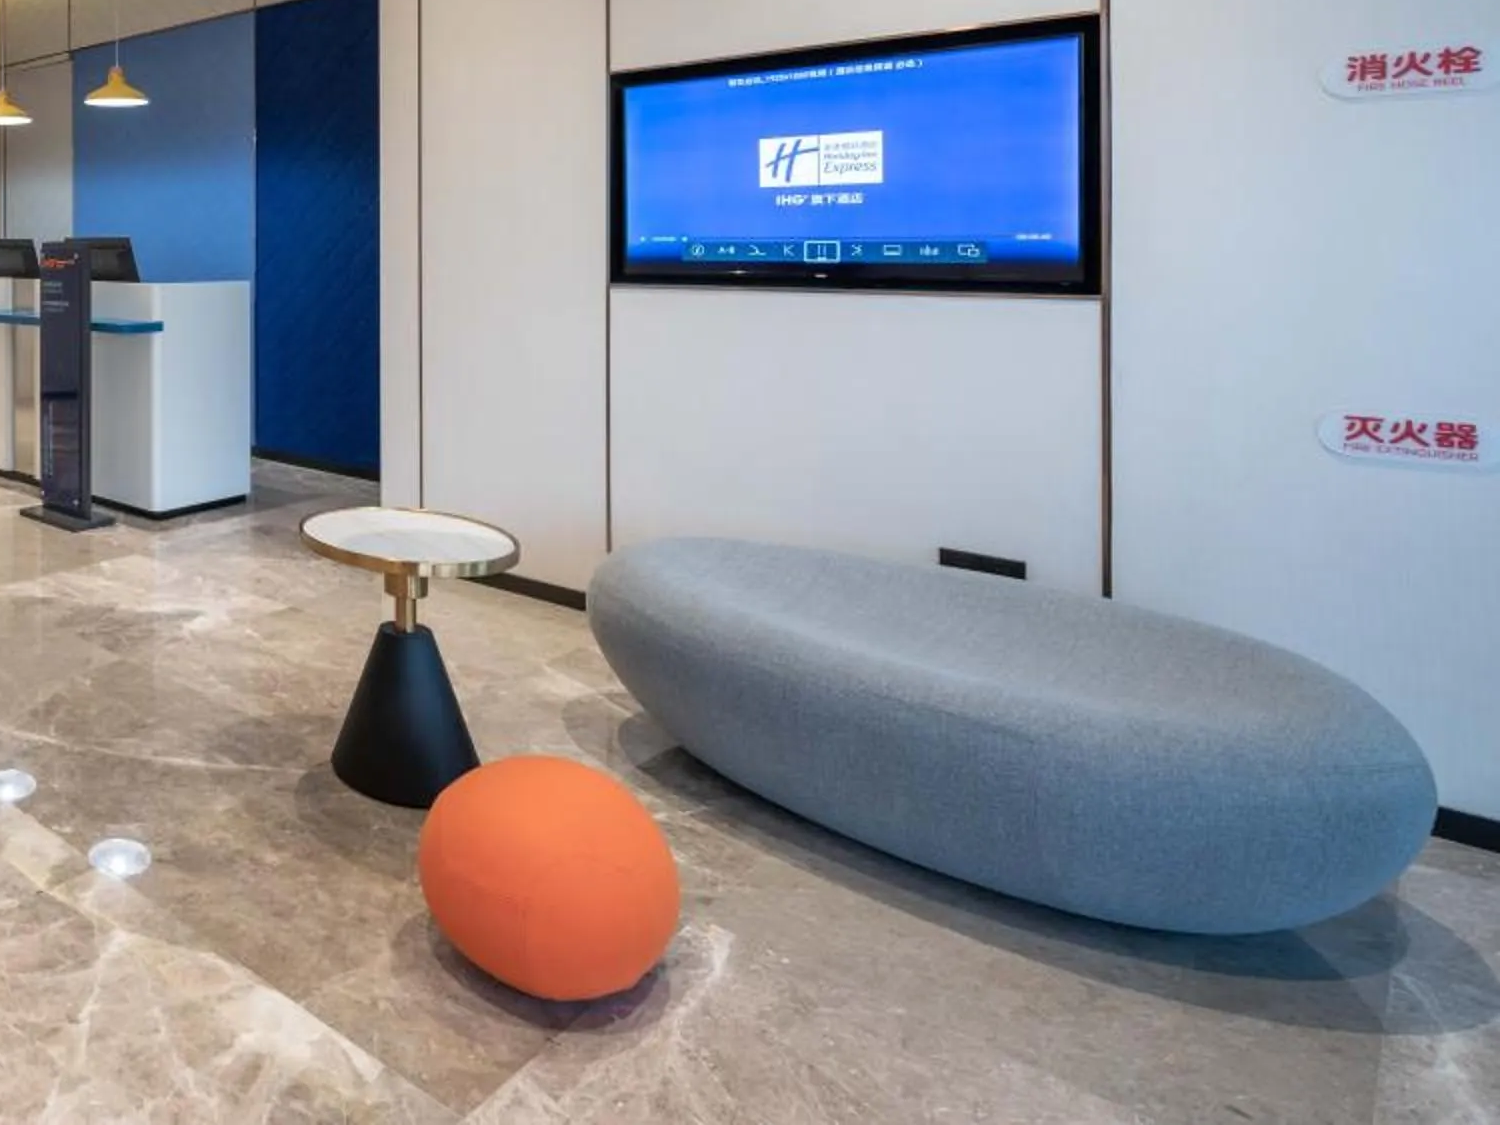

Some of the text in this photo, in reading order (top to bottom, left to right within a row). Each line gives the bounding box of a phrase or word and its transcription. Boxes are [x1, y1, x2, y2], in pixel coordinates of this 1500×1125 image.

[1347, 46, 1483, 82] 消火栓
[1344, 415, 1478, 450] 灭火器
